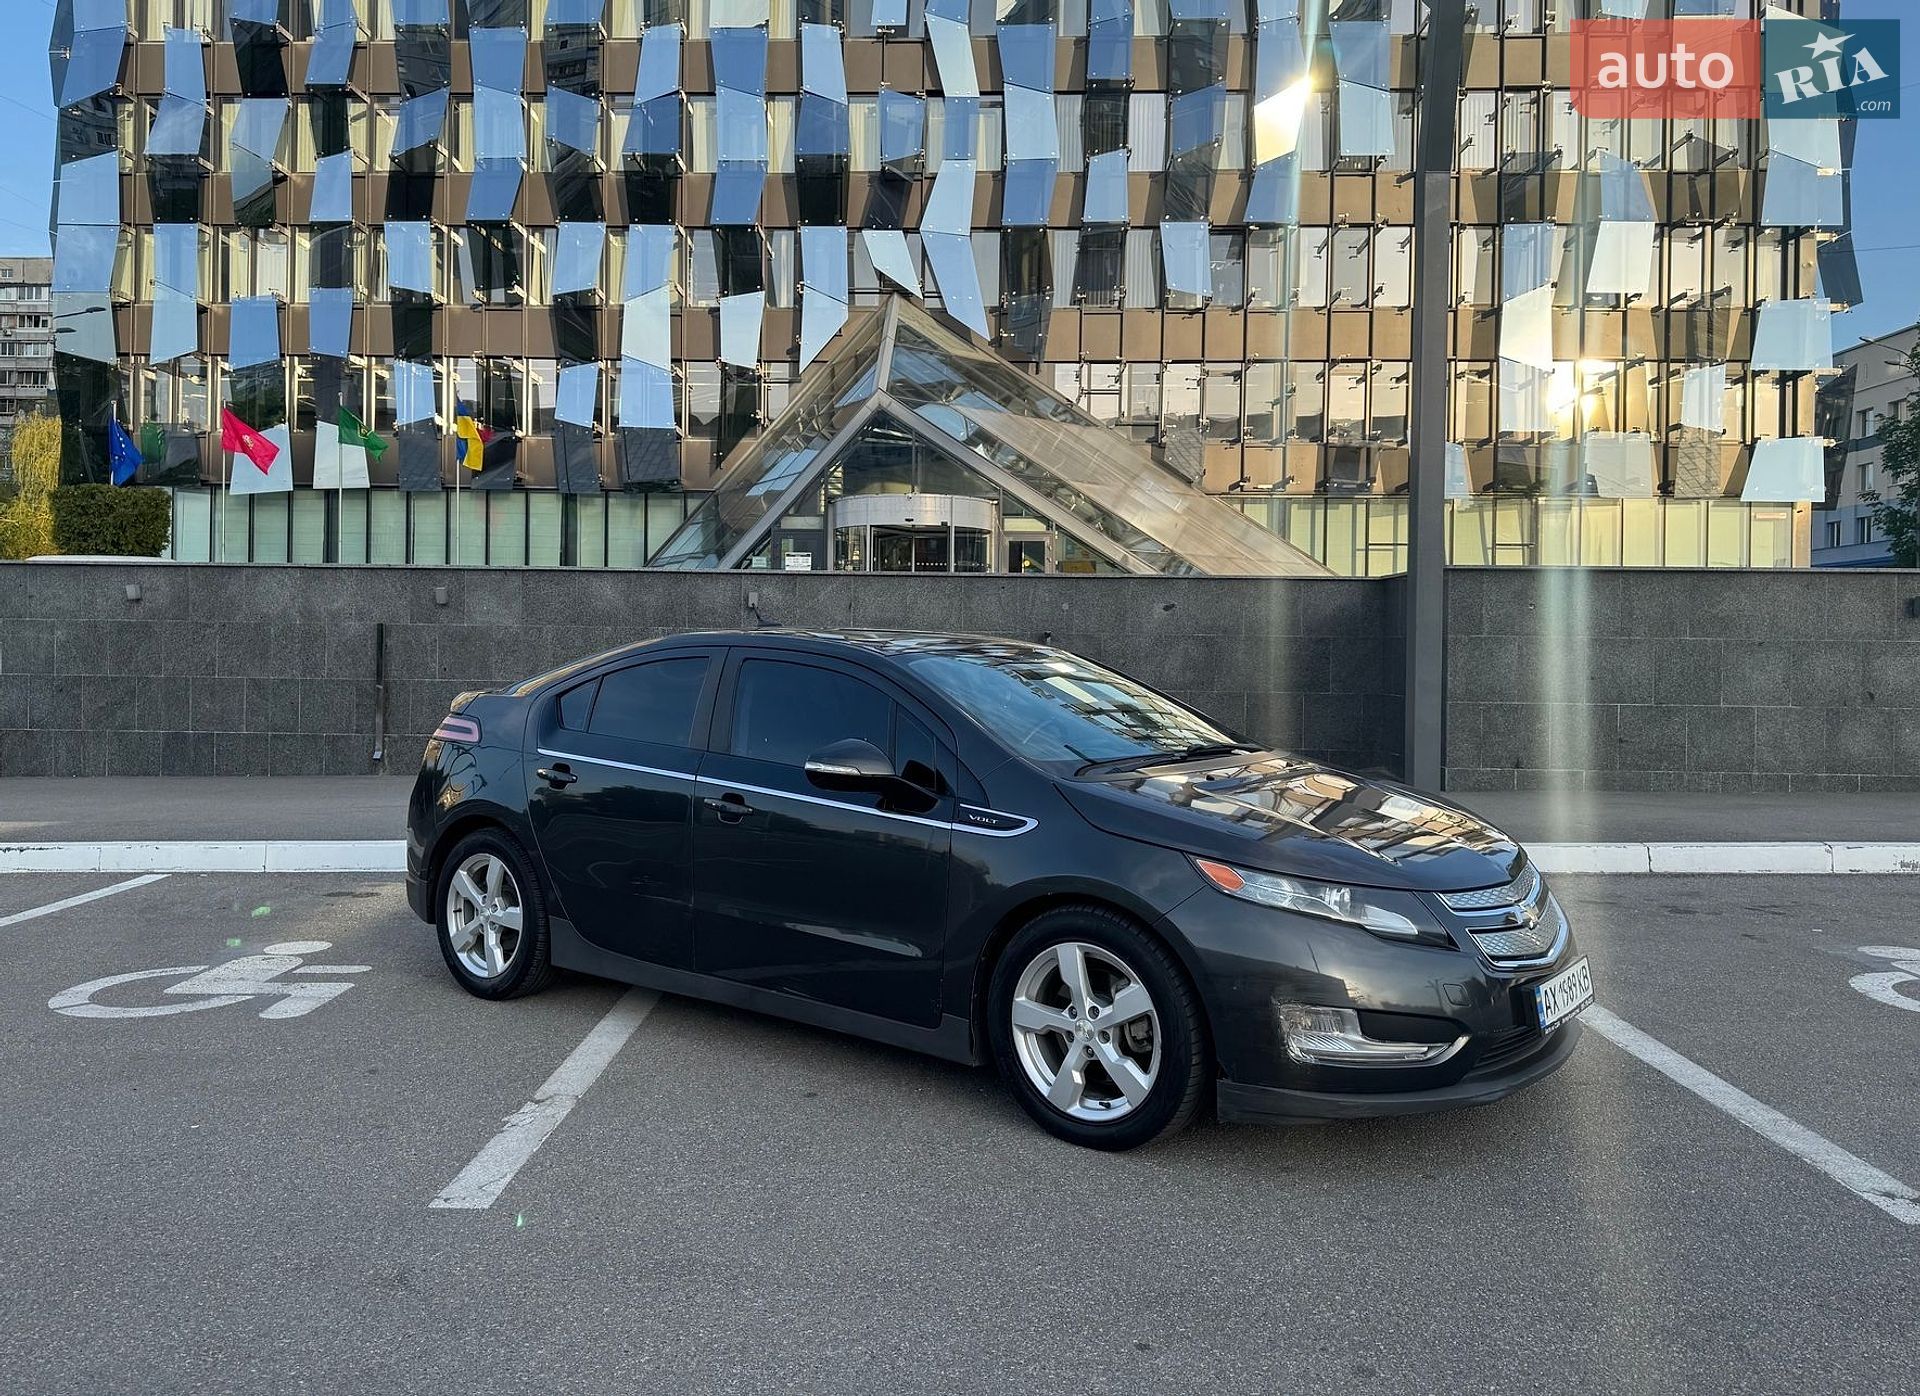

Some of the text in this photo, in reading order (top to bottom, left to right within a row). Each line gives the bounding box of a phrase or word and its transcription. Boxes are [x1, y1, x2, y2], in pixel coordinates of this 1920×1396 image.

[969, 814, 998, 824] VOLT
[1543, 988, 1560, 1018] AX
[1577, 965, 1590, 994] KB
